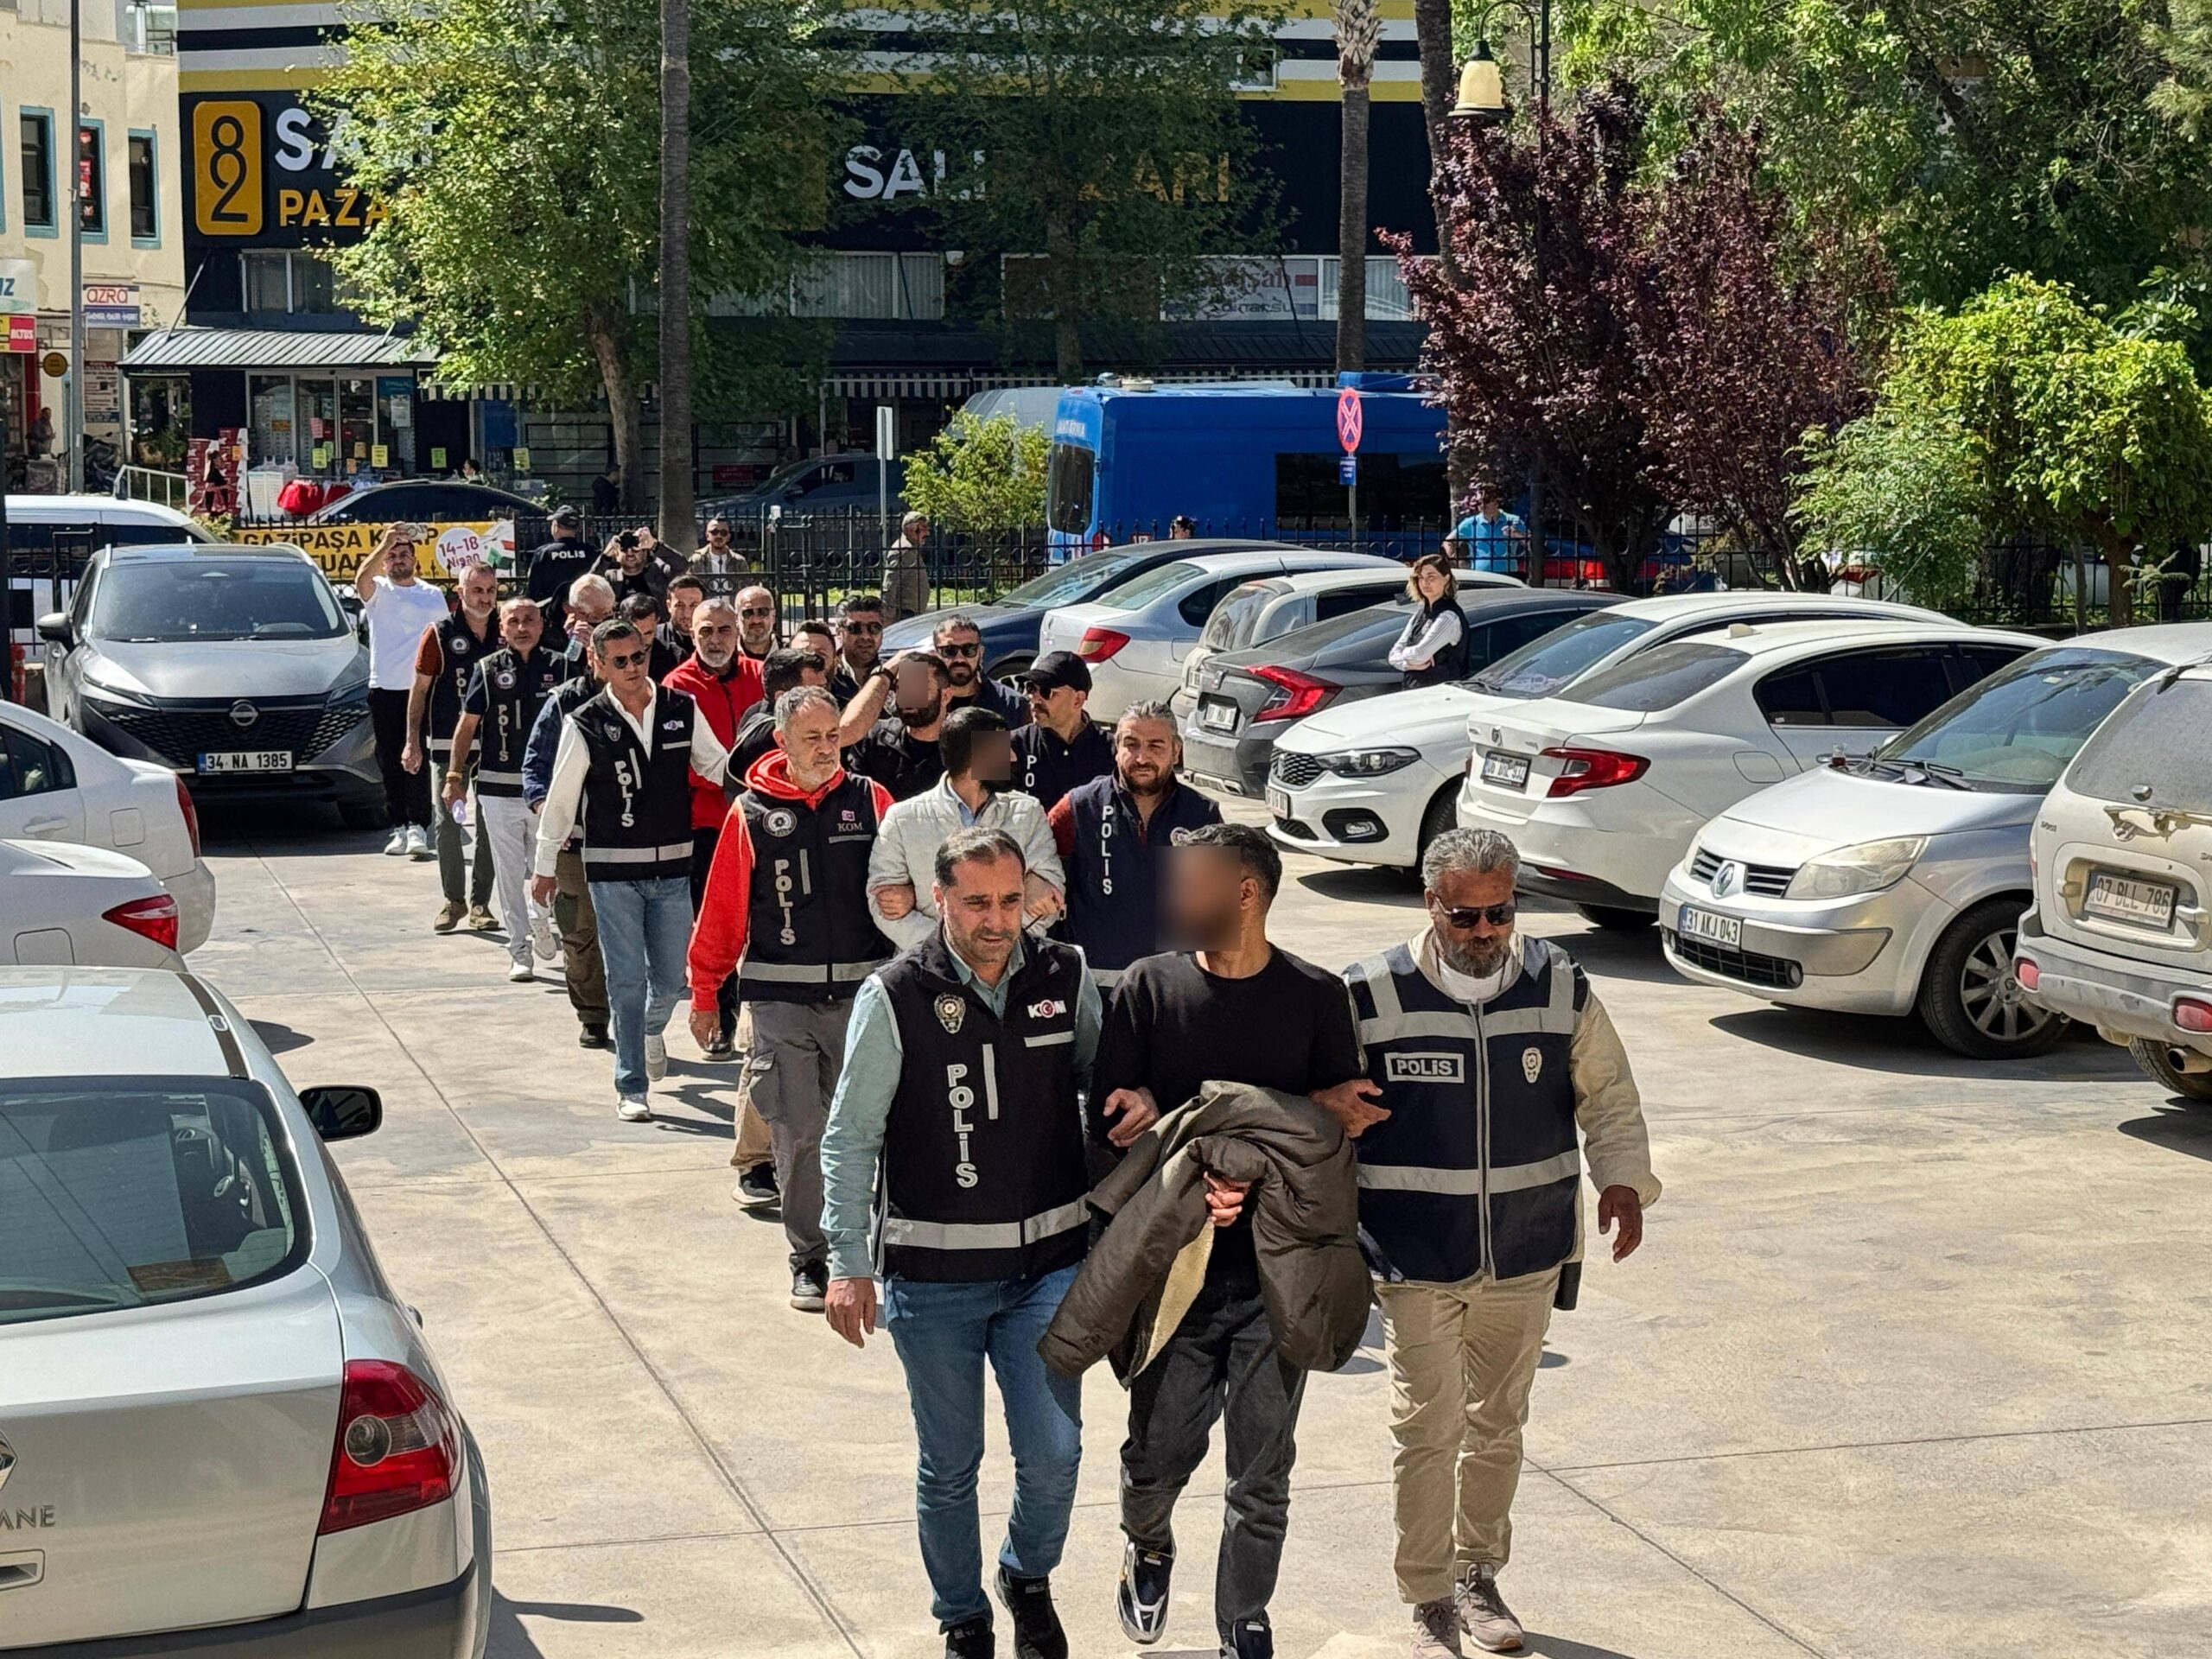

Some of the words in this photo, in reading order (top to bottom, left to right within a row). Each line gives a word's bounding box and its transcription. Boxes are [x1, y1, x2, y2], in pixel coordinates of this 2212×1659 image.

[439, 536, 480, 557] 14-18
[455, 668, 467, 697] POL
[207, 754, 225, 770] 34
[232, 753, 249, 769] NA
[257, 753, 288, 768] 1385
[836, 823, 864, 832] KOM
[2095, 877, 2113, 904] 07
[2115, 881, 2139, 911] BLL
[1687, 910, 1699, 931] 31
[1700, 913, 1718, 938] AKJ
[1719, 918, 1738, 943] 043
